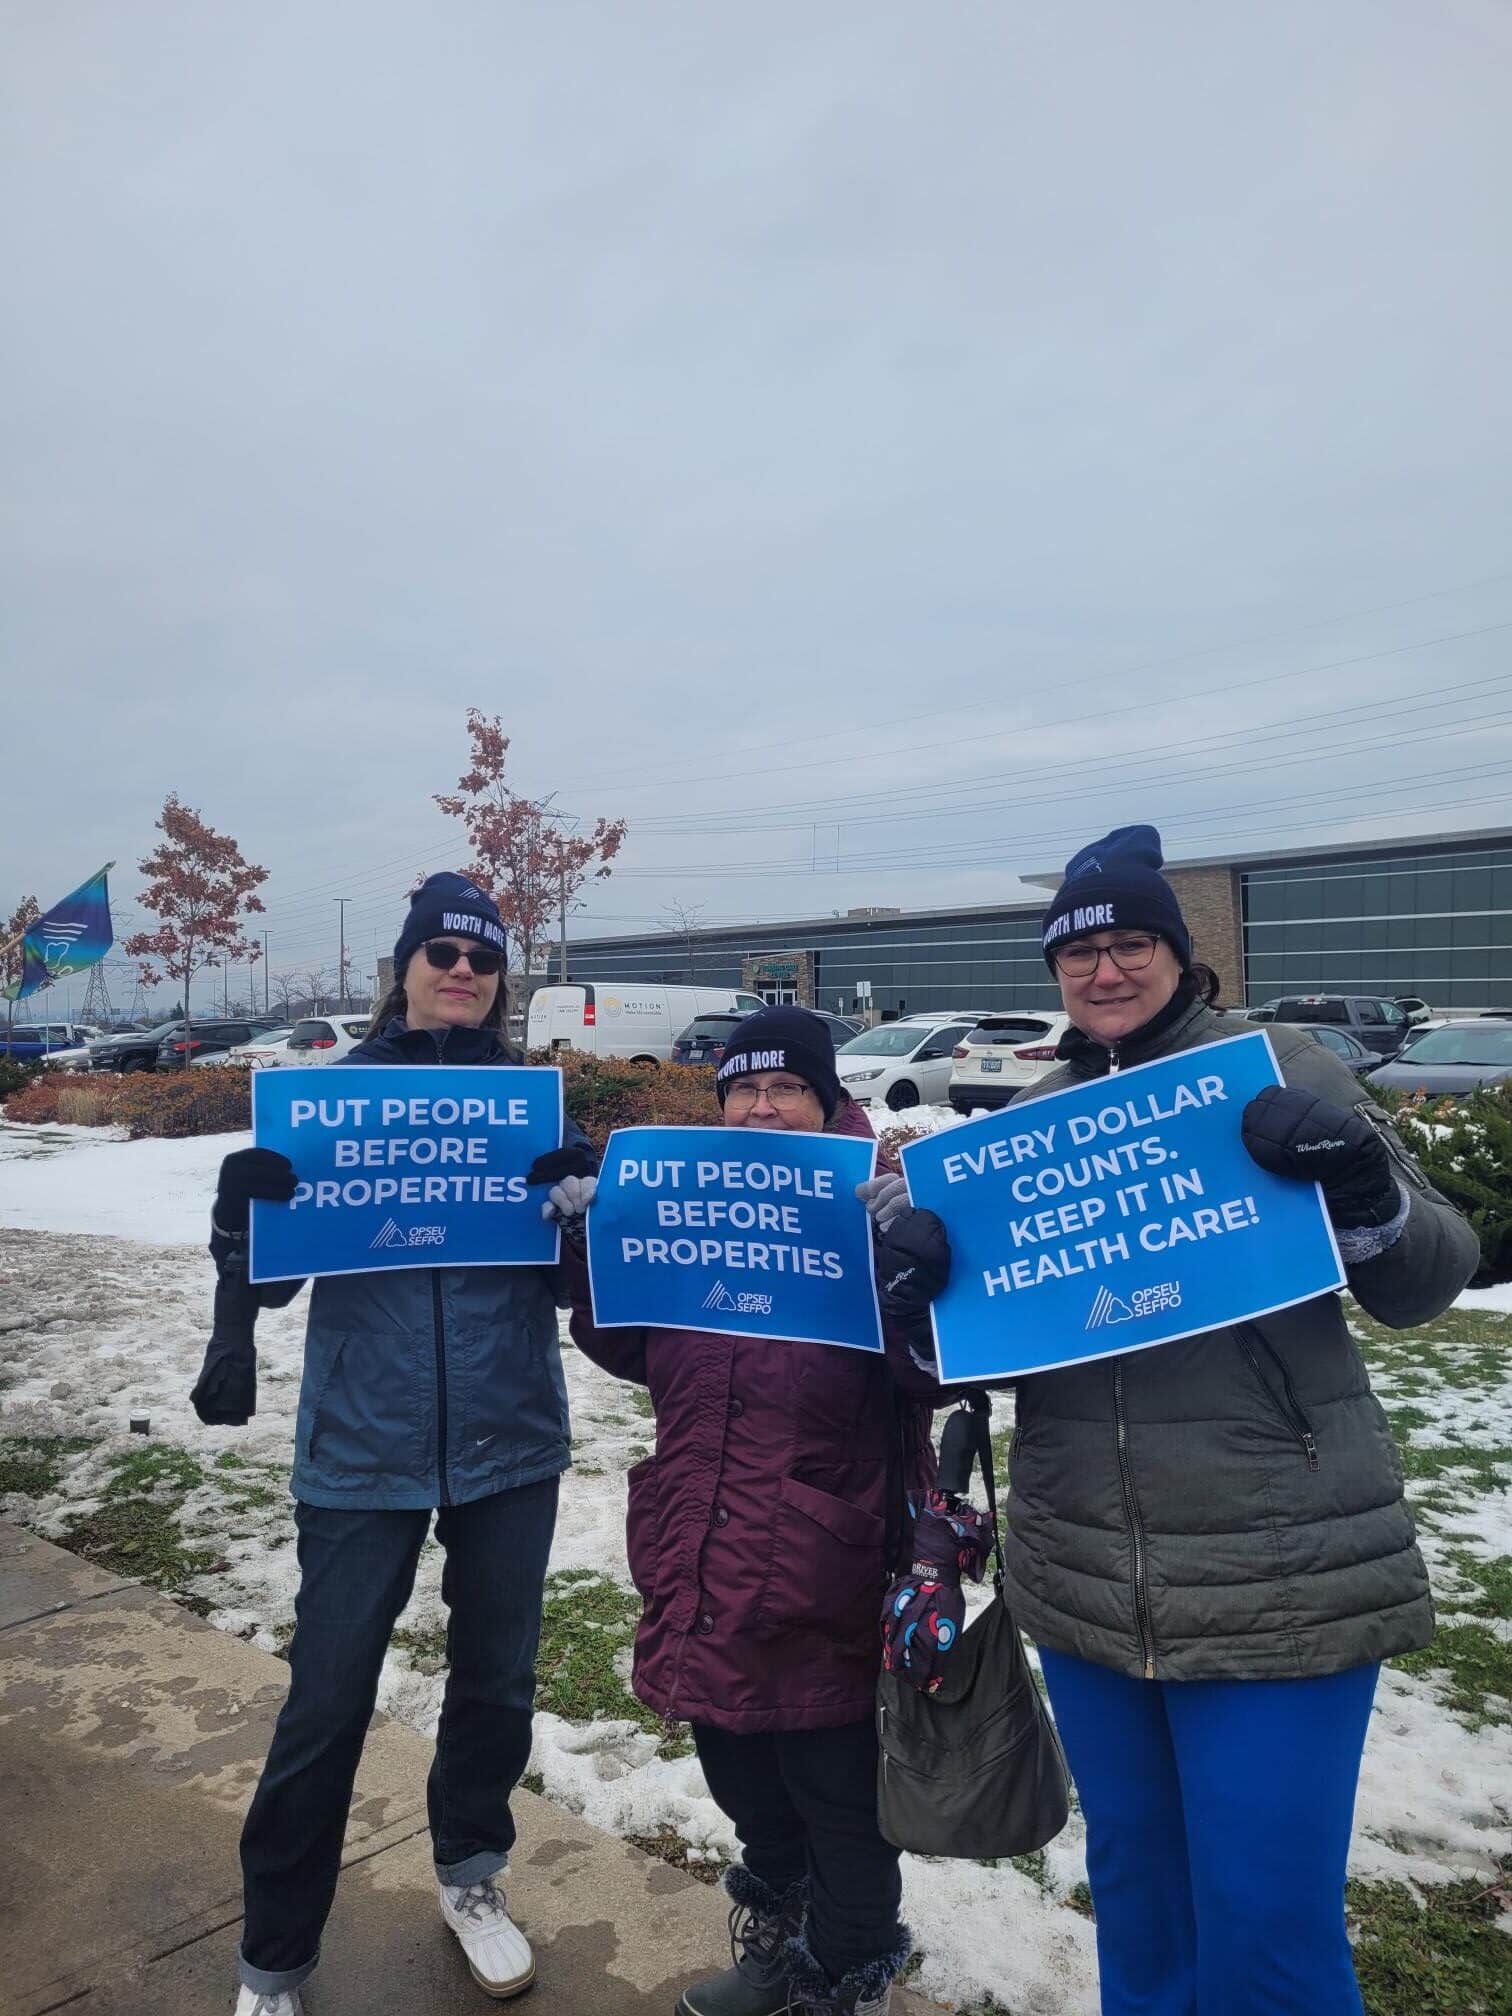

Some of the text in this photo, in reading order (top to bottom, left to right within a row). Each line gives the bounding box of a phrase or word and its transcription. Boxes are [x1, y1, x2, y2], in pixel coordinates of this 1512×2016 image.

[443, 912, 482, 935] WORTH
[1074, 903, 1115, 931] MORE
[751, 1050, 785, 1070] MORE
[290, 1098, 529, 1128] PUT PEOPLE
[942, 1075, 1229, 1184] EVERY DOLLAR
[335, 1137, 488, 1168] BEFORE
[618, 1159, 834, 1200] PUT PEOPLE
[1011, 1136, 1178, 1204] COUNTS.
[289, 1176, 528, 1210] PROPERTIES
[1009, 1168, 1205, 1248] KEEP IT IN
[409, 1226, 447, 1237] OPSEU
[657, 1200, 802, 1234] BEFORE
[408, 1235, 445, 1246] SEFPO
[983, 1196, 1261, 1297] HEALTH CARE!
[621, 1237, 844, 1280] PROPERTIES
[737, 1292, 773, 1305] OPSEU
[1131, 1281, 1180, 1304] OPSEU
[1134, 1294, 1182, 1318] SEFPO
[737, 1303, 772, 1315] SEFPO
